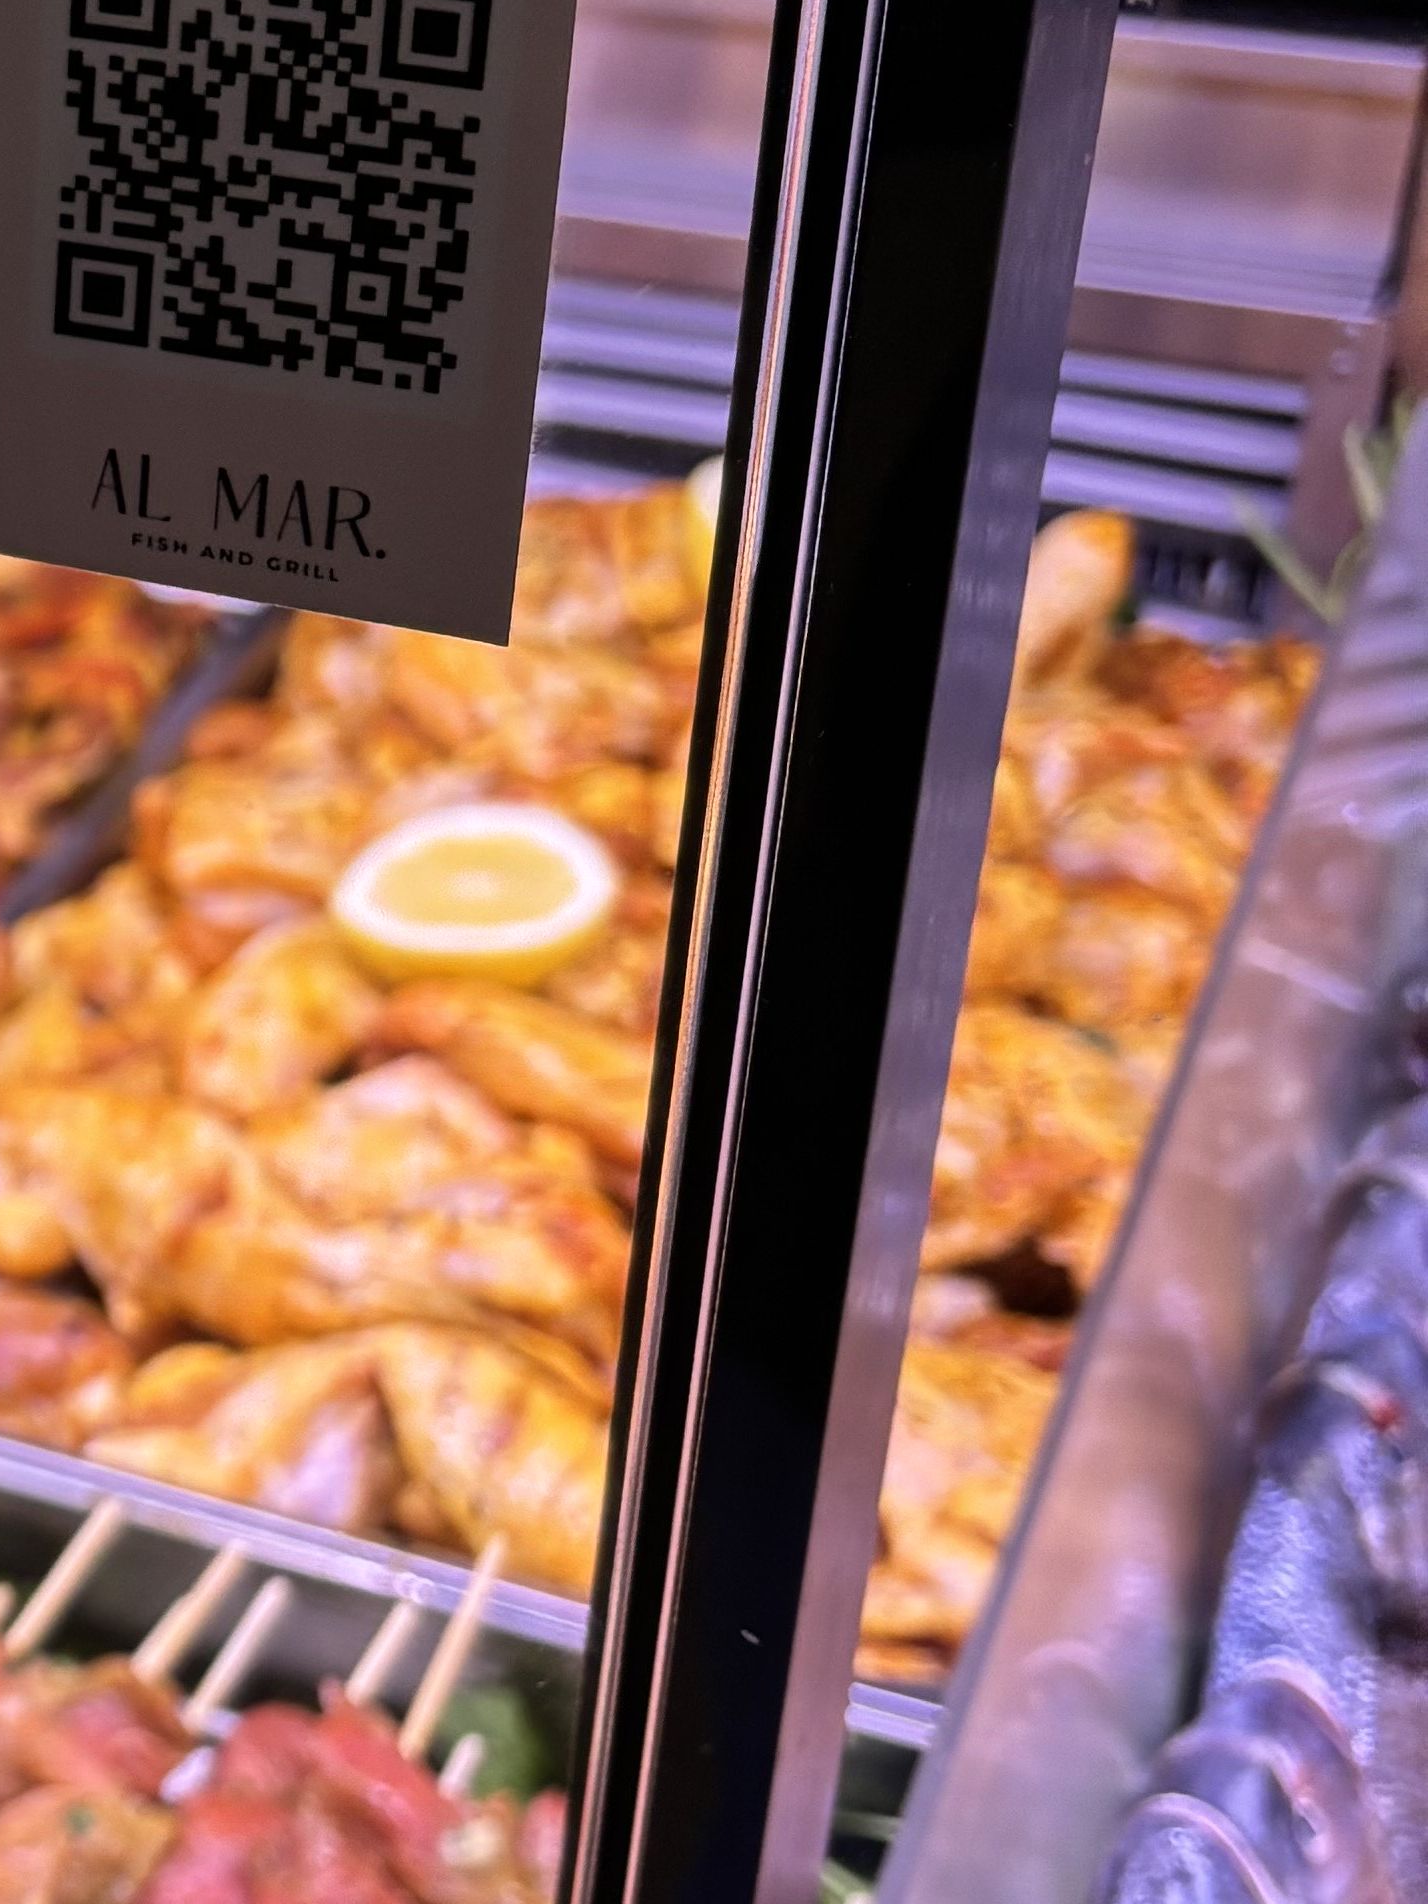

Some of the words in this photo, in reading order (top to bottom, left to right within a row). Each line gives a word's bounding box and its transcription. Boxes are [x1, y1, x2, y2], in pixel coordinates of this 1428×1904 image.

[90, 447, 172, 523] AL
[131, 531, 190, 556] FISH
[199, 544, 255, 567] AND
[265, 555, 341, 583] GRILL
